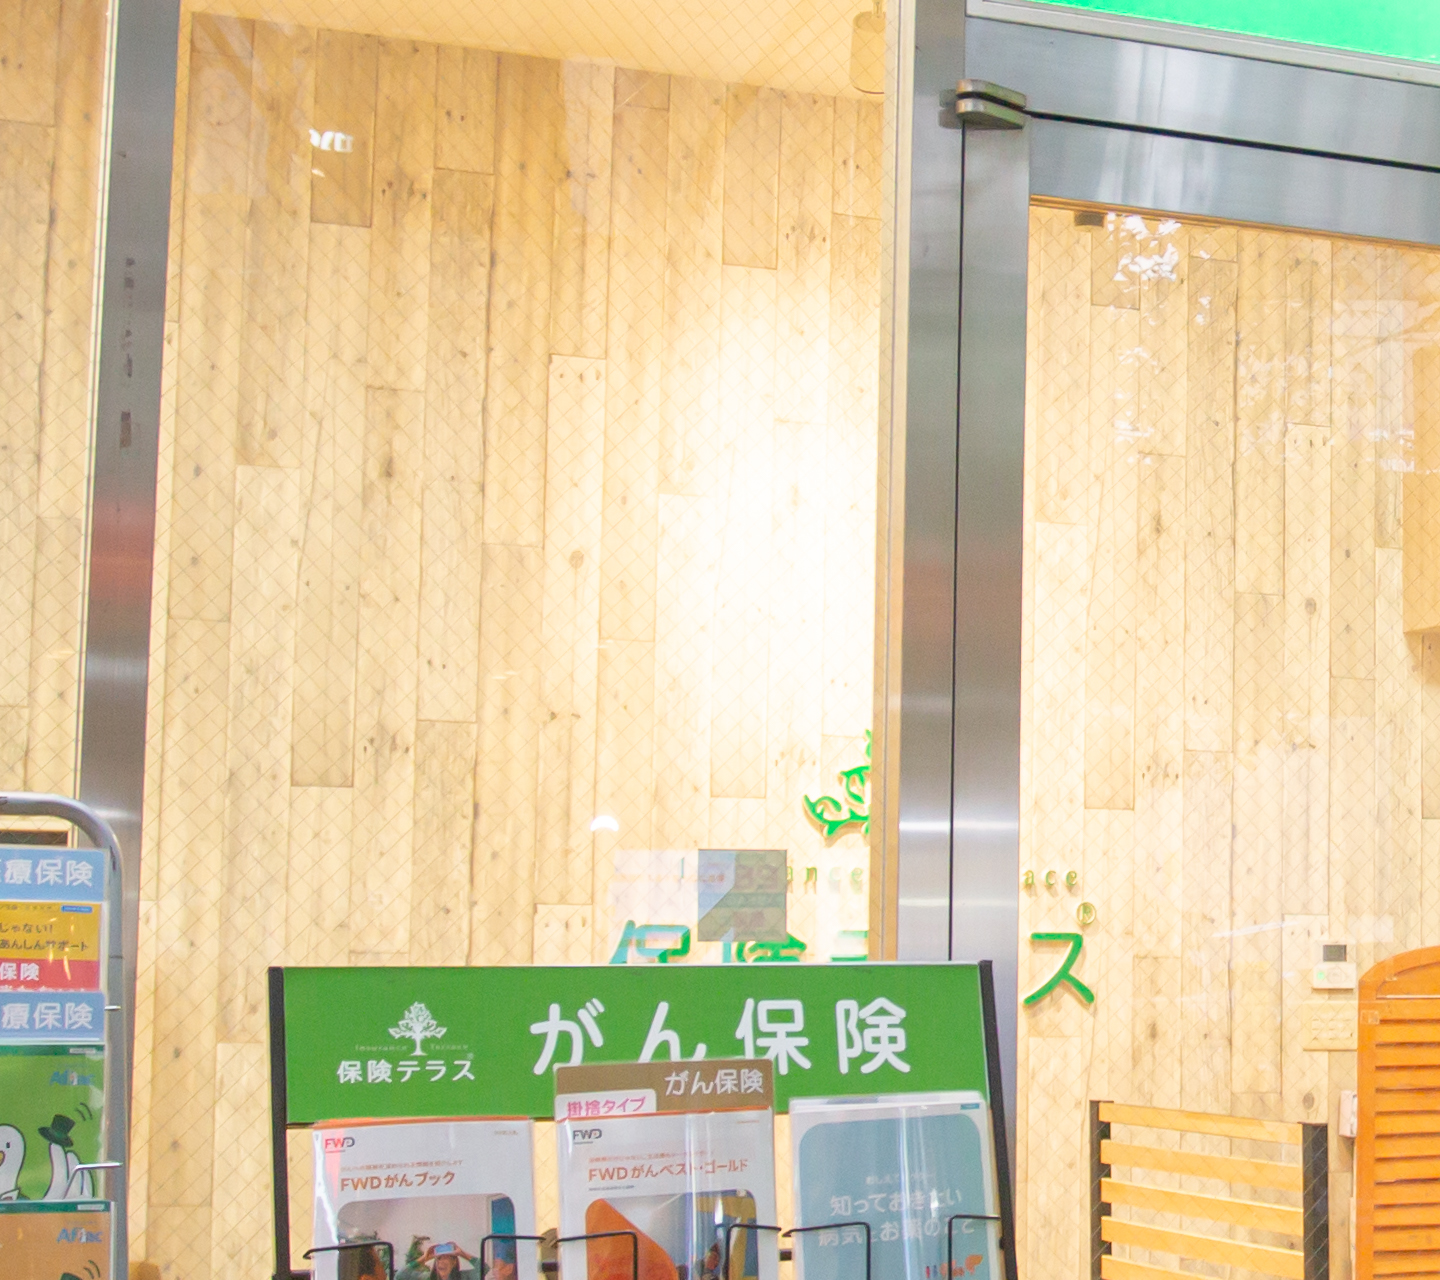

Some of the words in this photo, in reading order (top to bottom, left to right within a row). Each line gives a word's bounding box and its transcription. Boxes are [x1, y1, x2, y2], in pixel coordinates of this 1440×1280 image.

[530, 996, 913, 1077] がん保険
[337, 1060, 476, 1083] 保険テラス
[665, 1069, 765, 1096] がん保険
[324, 1137, 355, 1149] FWD
[572, 1128, 602, 1141] FWD
[340, 1171, 456, 1192] FWDがんブック
[830, 1188, 962, 1218] 知っておきたい
